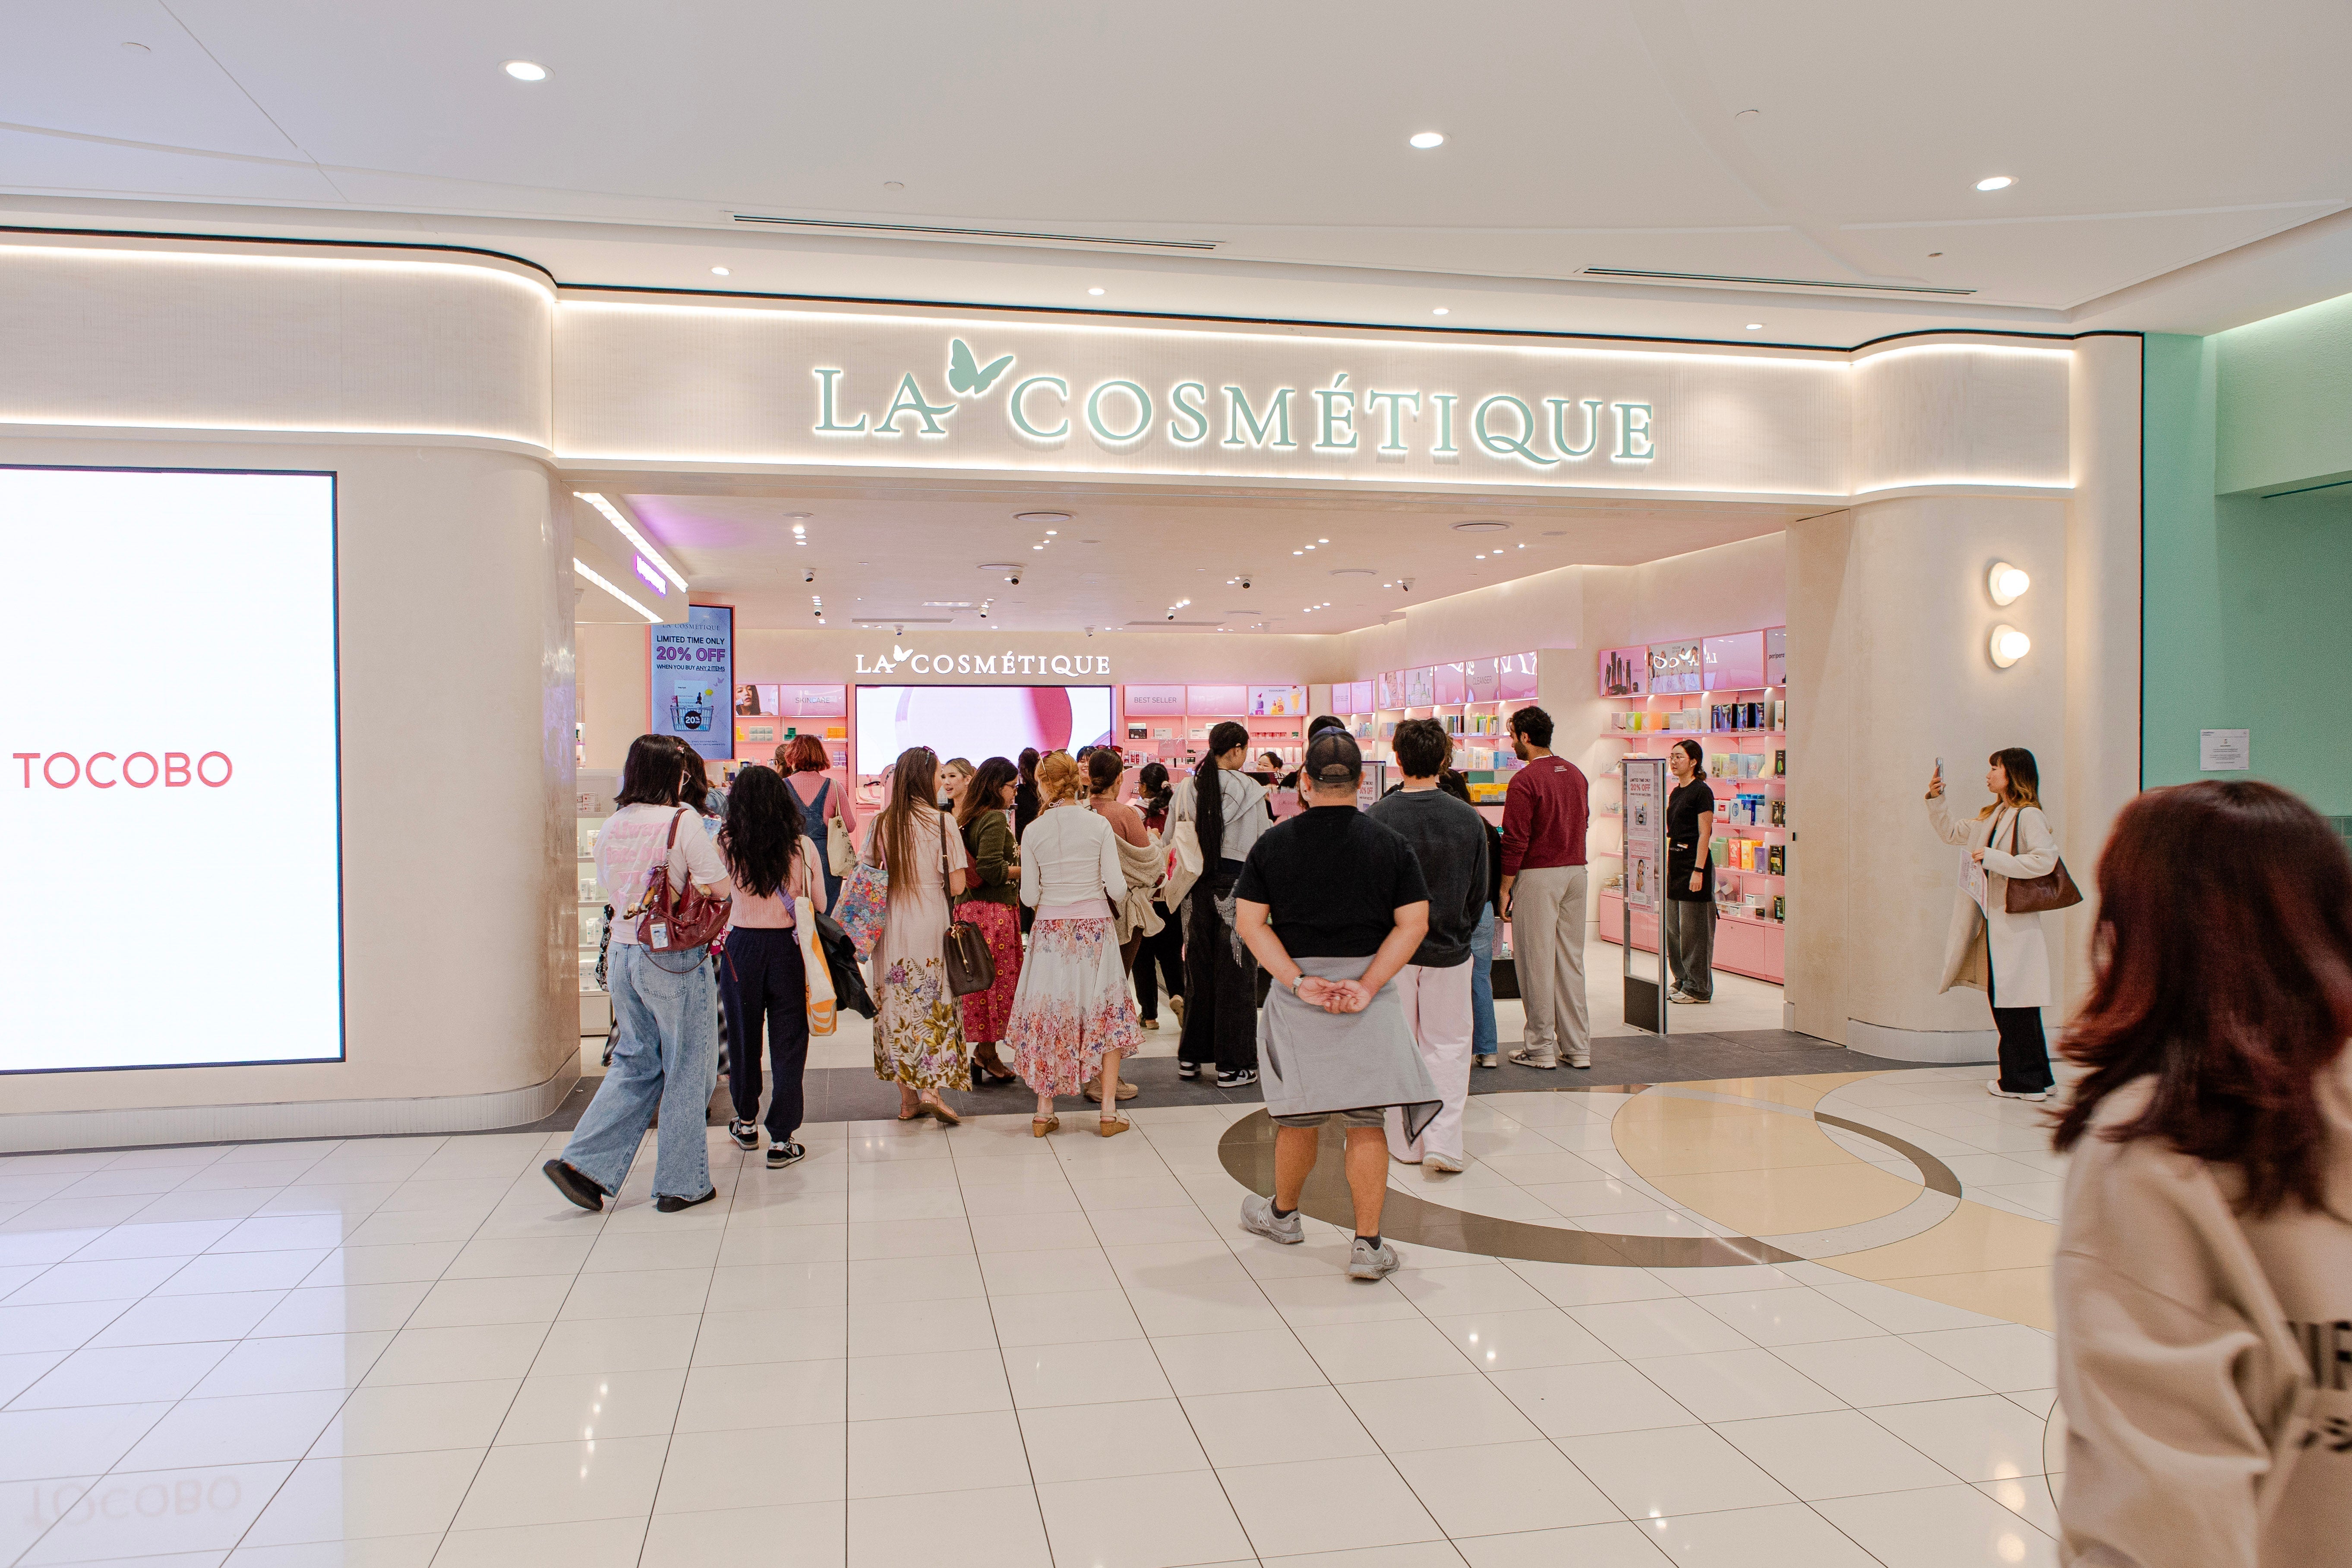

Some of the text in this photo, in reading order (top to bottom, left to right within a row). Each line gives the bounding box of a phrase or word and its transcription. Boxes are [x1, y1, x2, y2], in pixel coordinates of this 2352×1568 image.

[815, 369, 1654, 465] LA COSMÉTIQUE
[656, 646, 726, 662] 20% OFF
[856, 650, 1110, 677] LA COSMÉTIQUE
[1472, 676, 1493, 686] CLEANSER
[13, 751, 233, 789] TOCOBO
